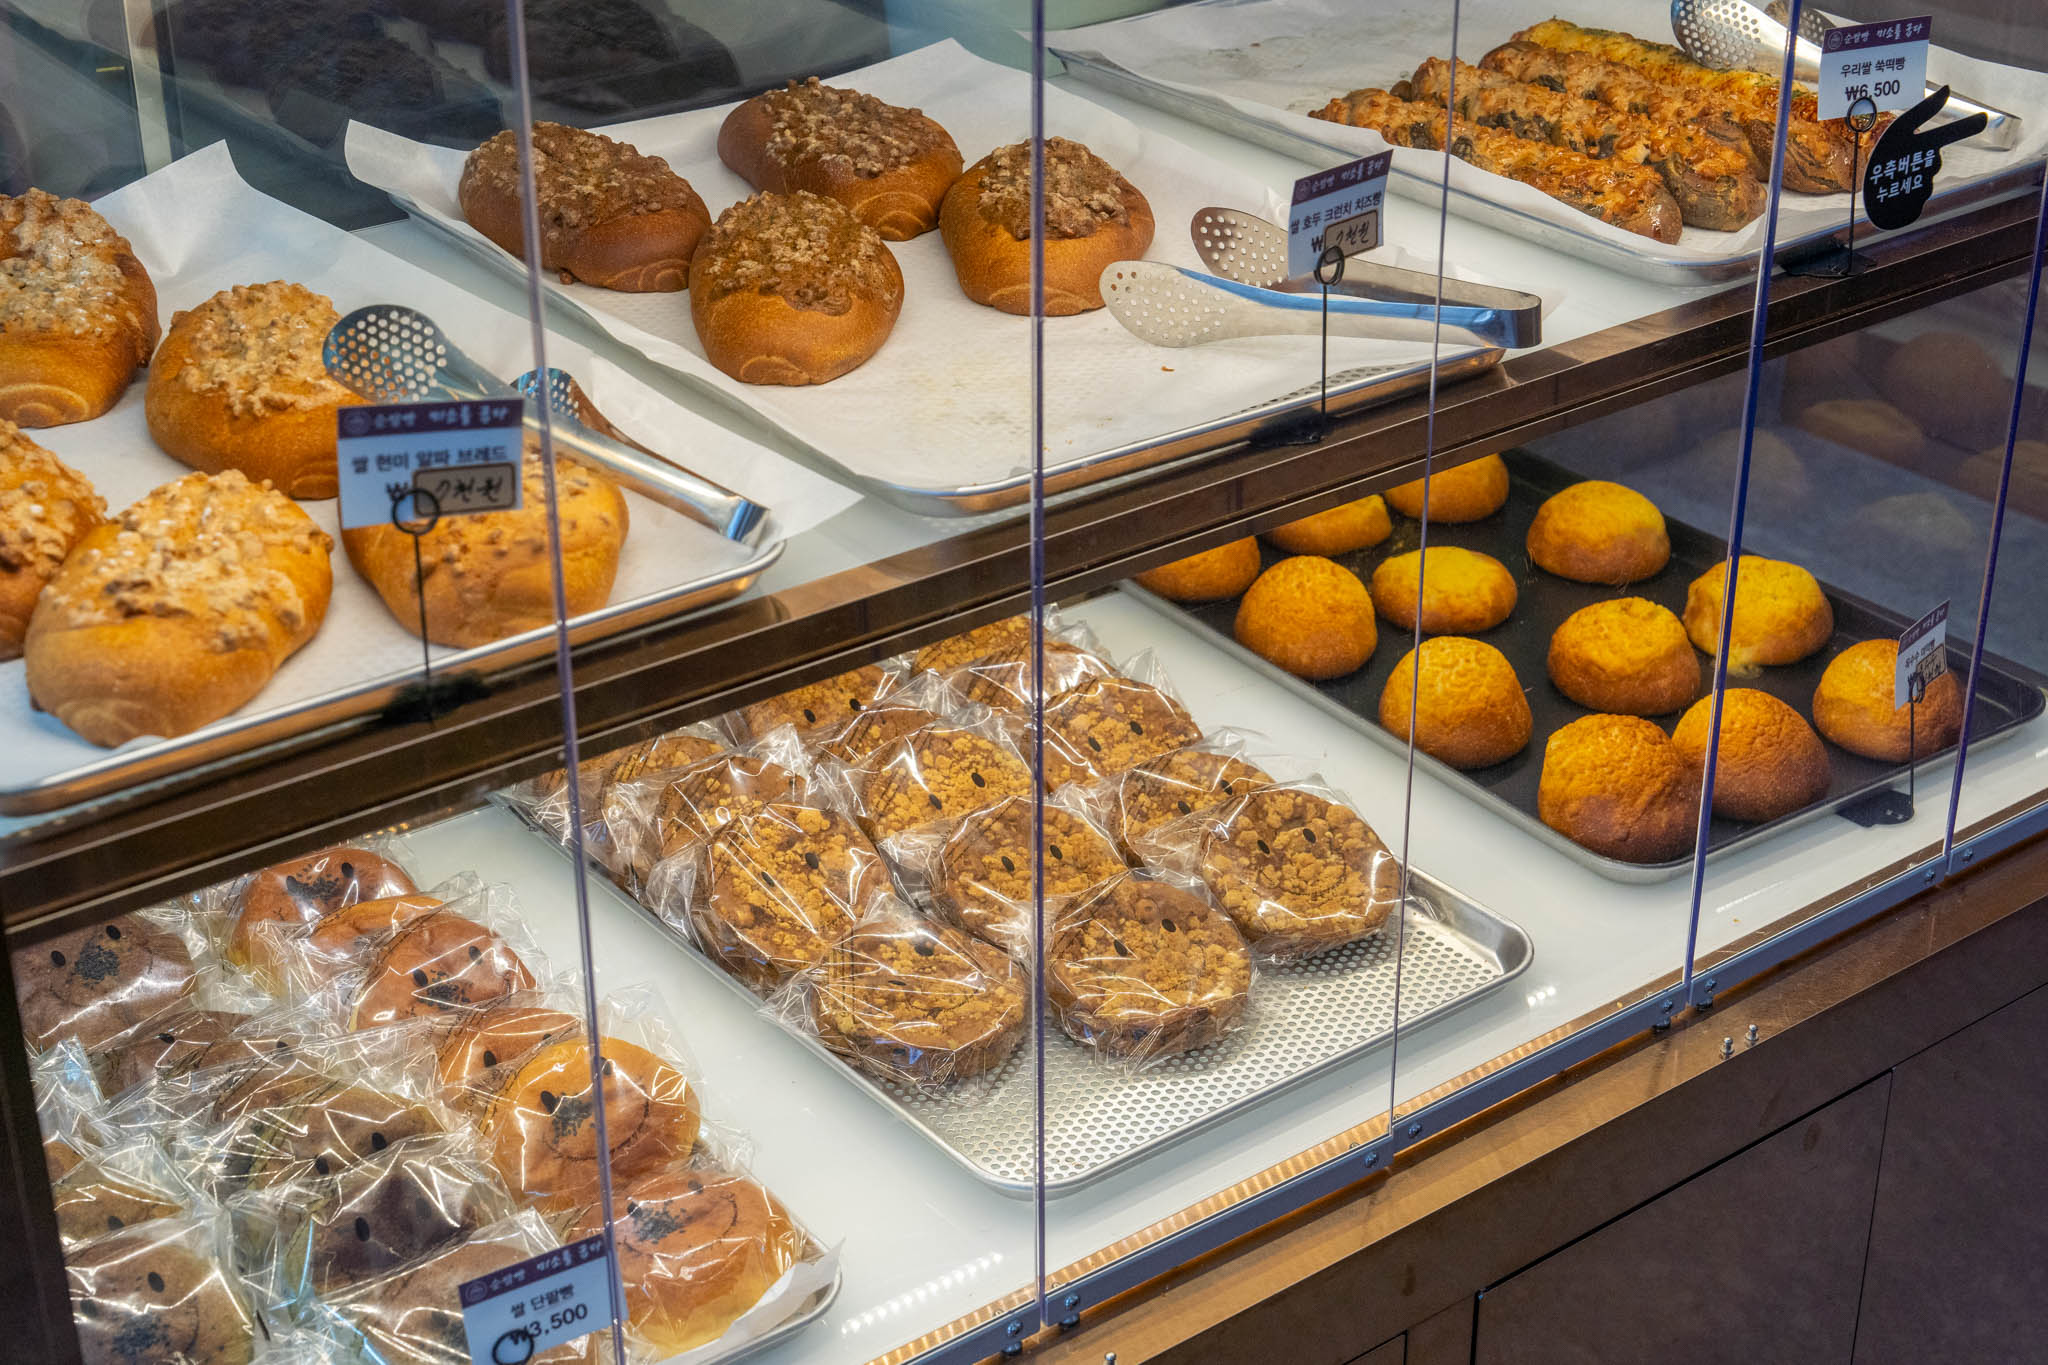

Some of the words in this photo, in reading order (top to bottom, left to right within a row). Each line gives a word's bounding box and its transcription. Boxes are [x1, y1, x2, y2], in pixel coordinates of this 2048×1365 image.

[1876, 23, 1902, 41] 미소를
[1840, 61, 1872, 78] 우리쌀
[1874, 56, 1906, 73] 쑥떡빵
[1870, 149, 1936, 184] 우측버튼을
[1876, 174, 1923, 203] 누르세요
[1303, 211, 1322, 230] 호두
[1324, 200, 1352, 222] 크런치
[1355, 190, 1382, 211] 치즈빵
[375, 453, 410, 472] 현미
[457, 446, 508, 464] 브레드
